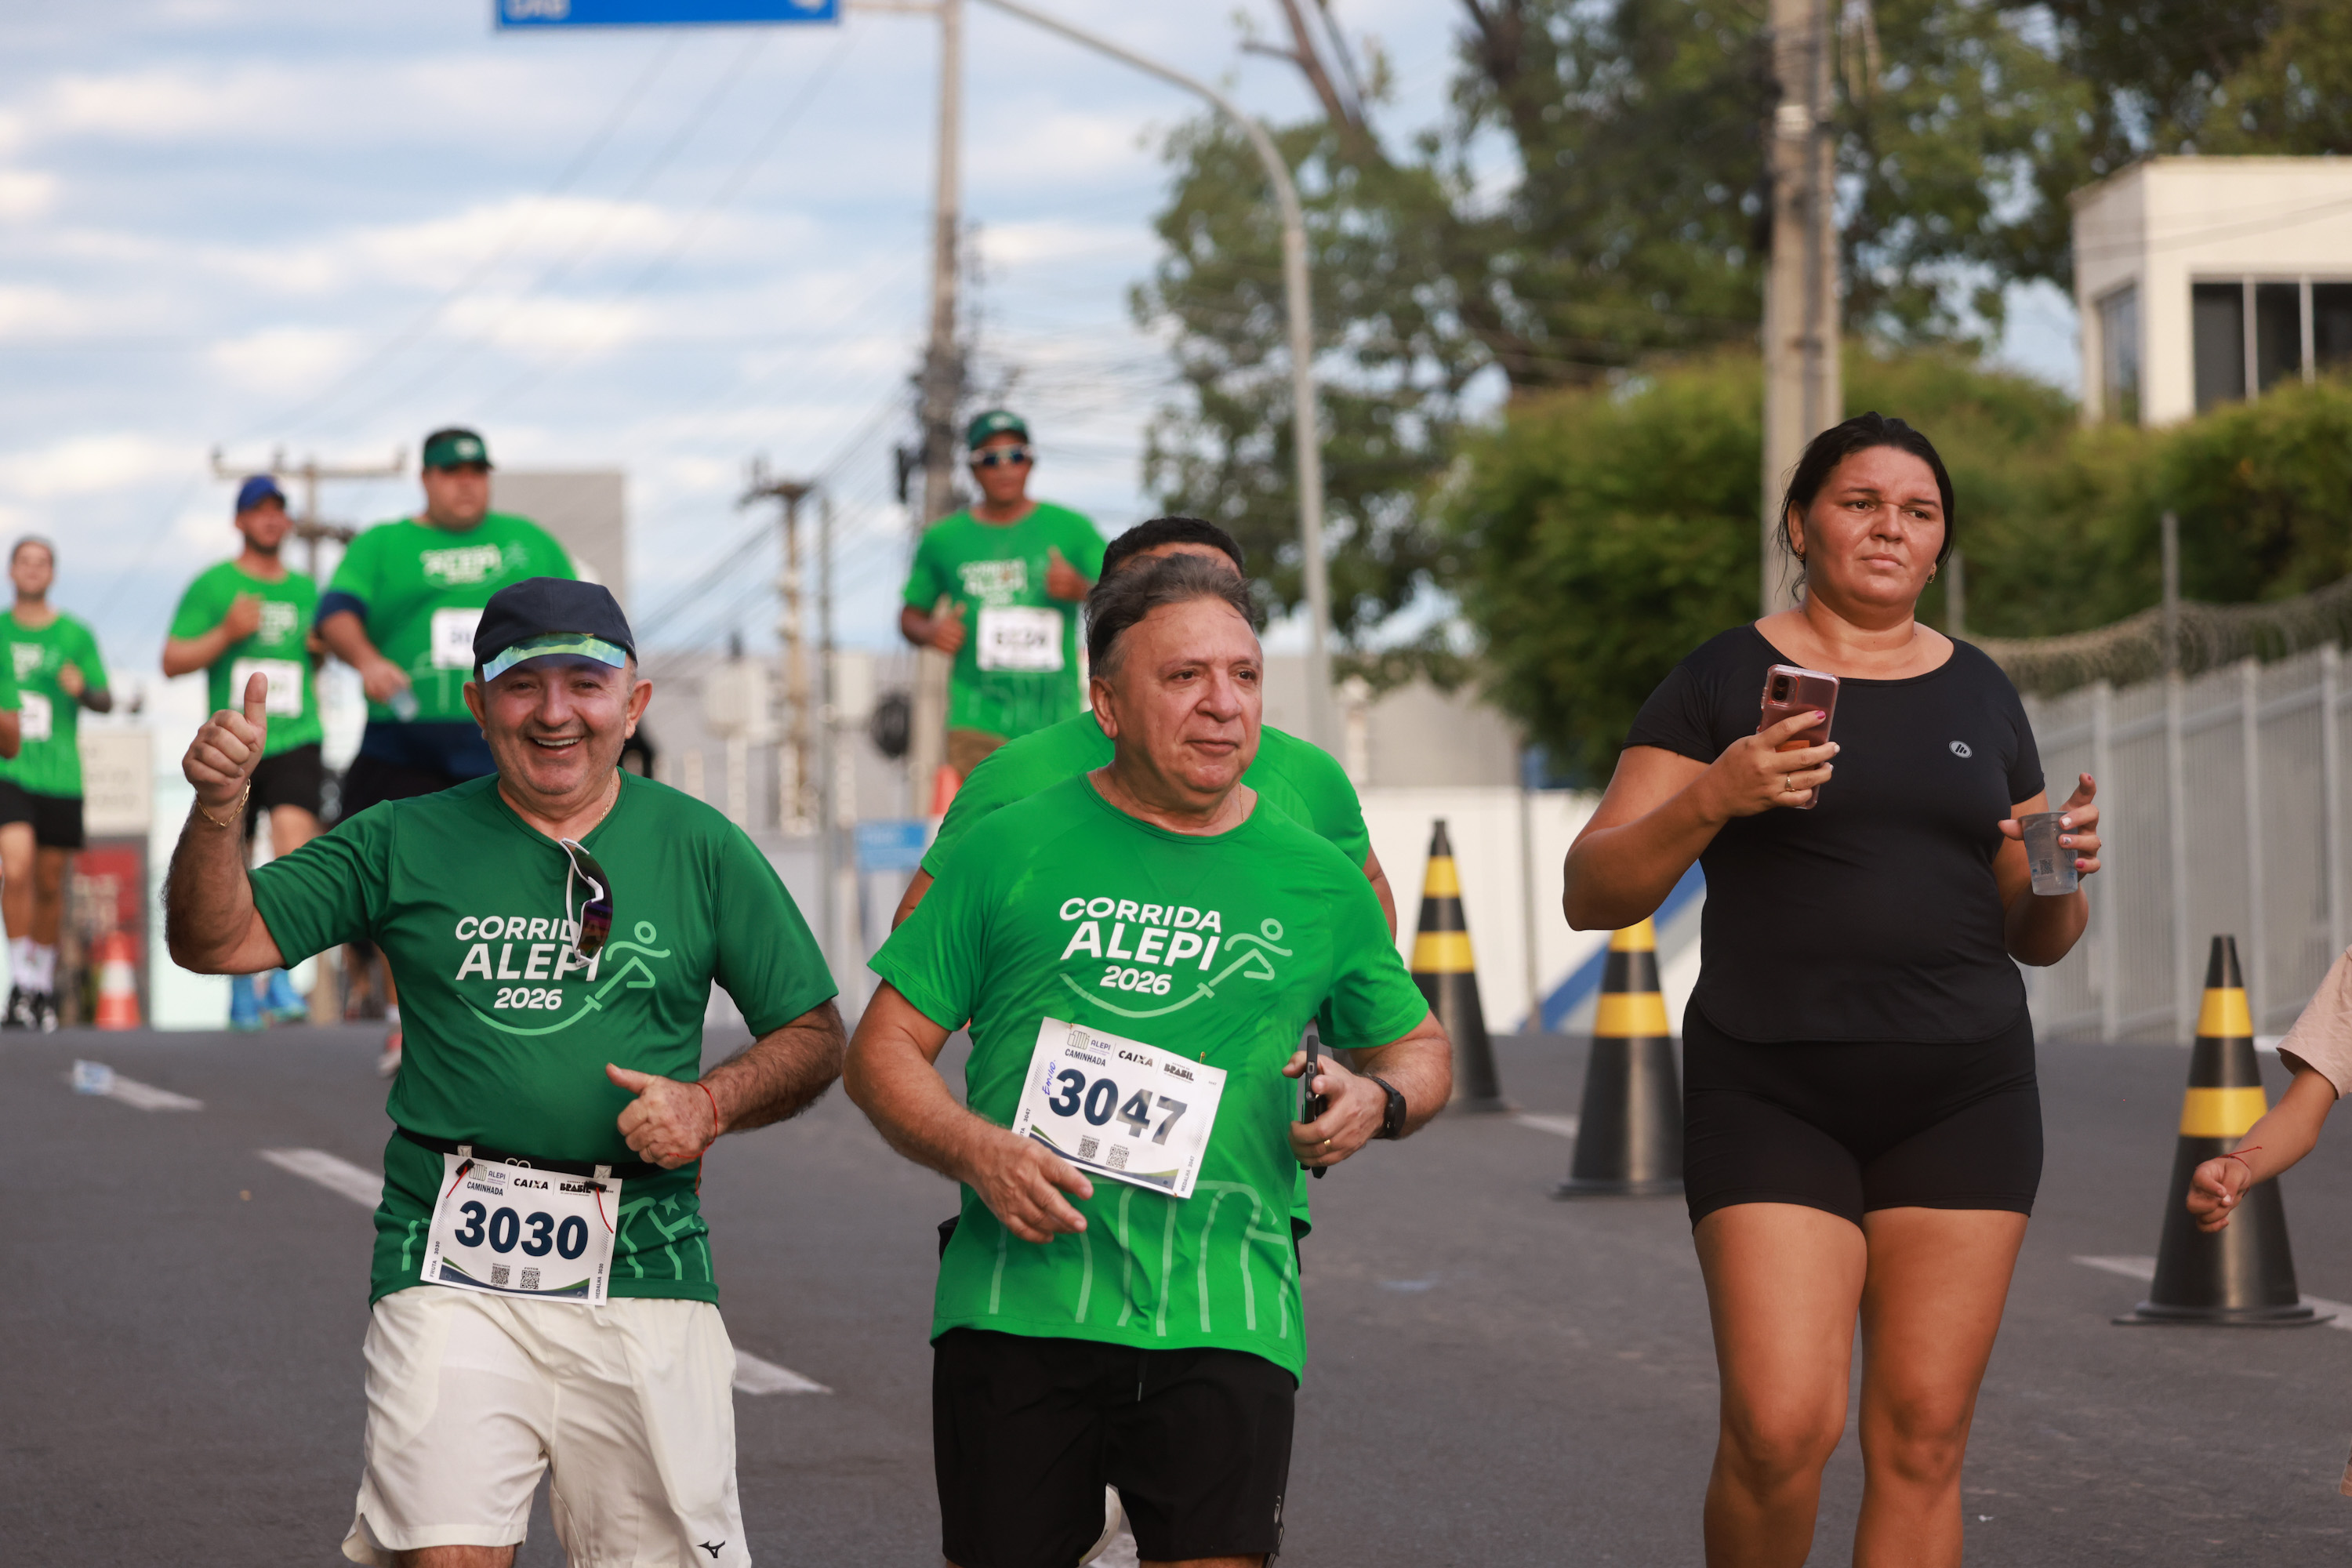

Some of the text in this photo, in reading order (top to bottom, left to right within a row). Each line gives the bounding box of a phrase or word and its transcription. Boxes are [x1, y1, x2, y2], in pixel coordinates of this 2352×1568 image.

[1059, 897, 1221, 933] CORRIDA
[455, 915, 582, 942] CORRID
[1059, 920, 1221, 971] ALEPI
[455, 943, 603, 982] ALEPI
[1099, 965, 1172, 996] 2026
[493, 987, 563, 1011] 2026
[1091, 1040, 1111, 1051] ALEPI
[1065, 1048, 1106, 1066] CAMINHADA
[1118, 1051, 1153, 1067] CAIXA
[1163, 1063, 1194, 1081] BRASIL
[1048, 1068, 1188, 1145] 3047
[488, 1171, 506, 1180] ALEPI
[514, 1178, 549, 1190] CAIXA
[1181, 1170, 1191, 1192] MEDALHA
[466, 1181, 503, 1196] CAMINHADA
[560, 1182, 591, 1193] BRASIL
[454, 1200, 588, 1260] 3030
